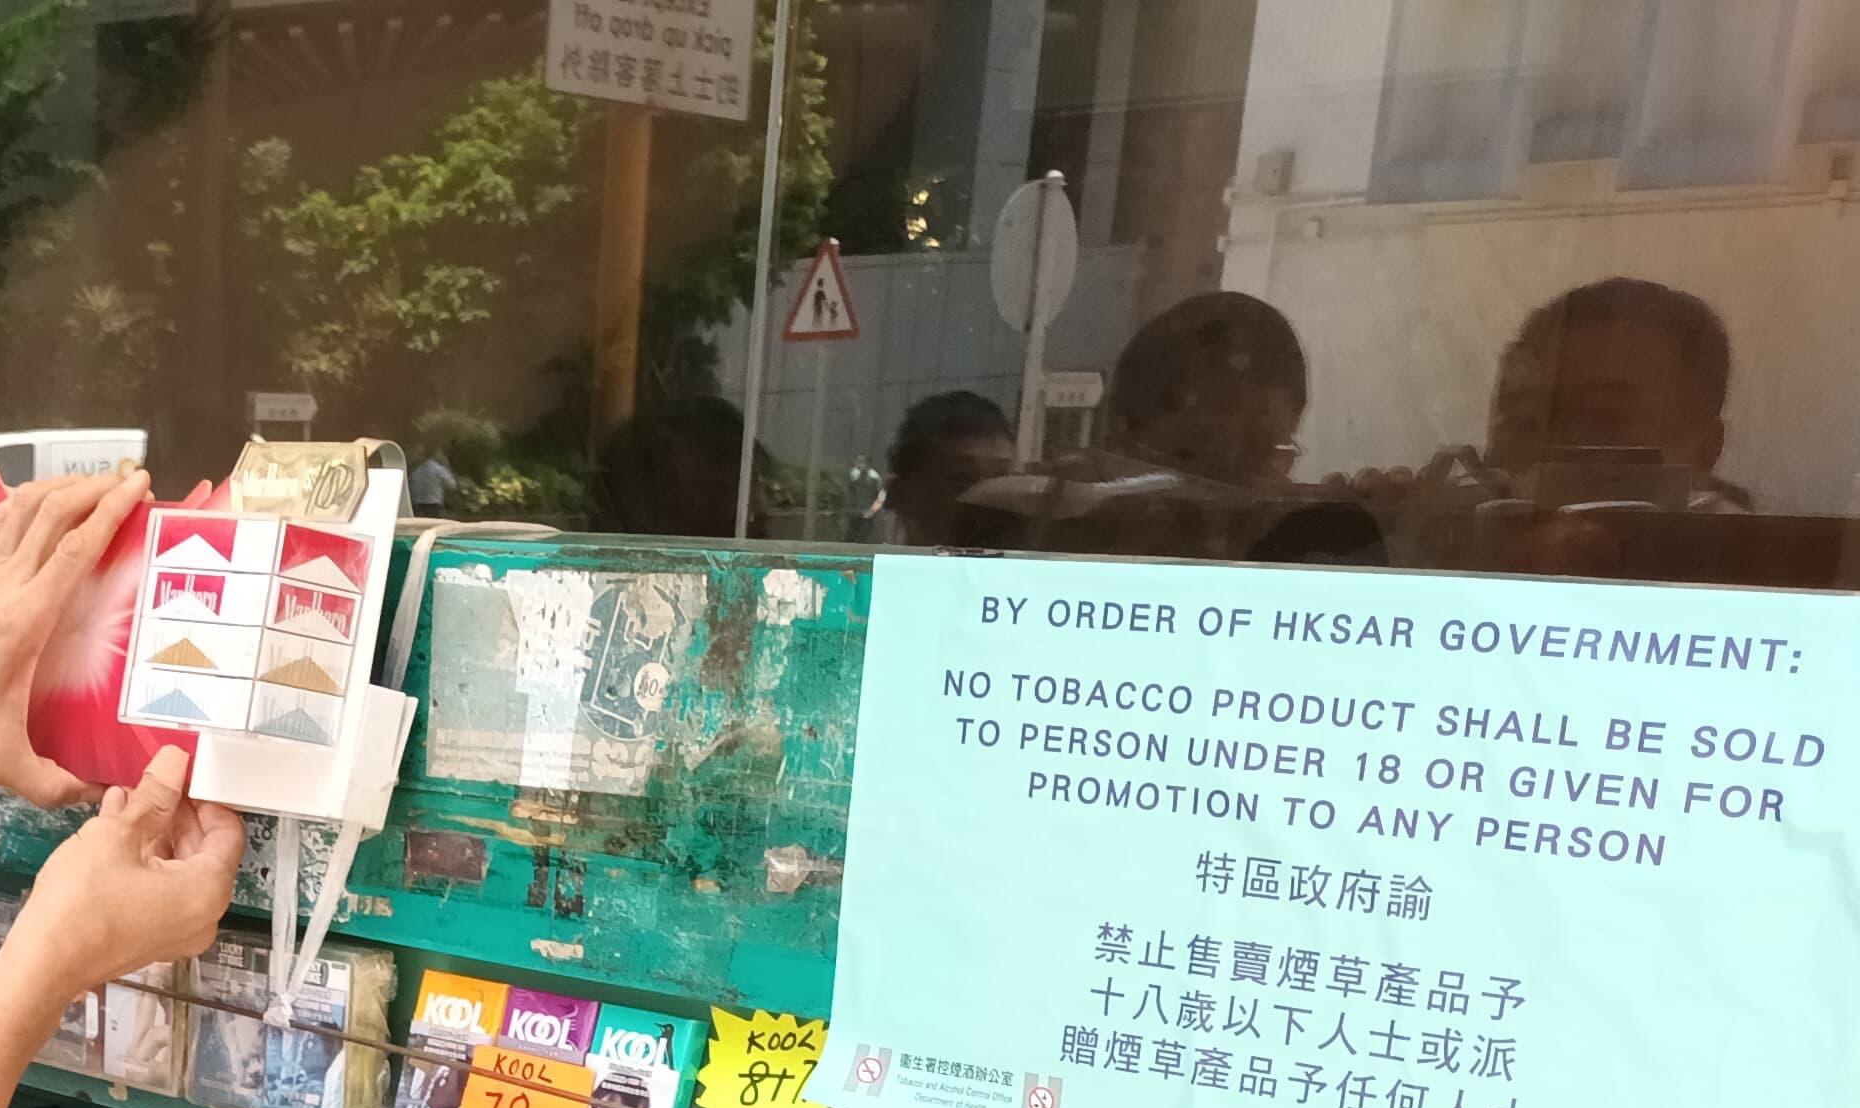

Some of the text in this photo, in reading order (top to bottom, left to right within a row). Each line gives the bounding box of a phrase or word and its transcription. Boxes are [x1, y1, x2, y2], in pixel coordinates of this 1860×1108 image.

[981, 595, 1803, 675] BY ORDER OF HKSAR GOVERNMENT:
[943, 668, 1826, 769] NO TOBACCO PRODUCT SHALL BE SOLD
[955, 717, 1785, 823] TO PERSON UNDER 18 OR GIVEN FOR
[1027, 771, 1667, 867] PROMOTION TO ANY PERSON
[1194, 849, 1434, 922] 特區政府諭
[1093, 920, 1527, 1022] 禁止售賣煙草產品予
[423, 991, 486, 1034] KOOL
[507, 1008, 574, 1051] KOOL
[1089, 975, 1517, 1083] 十八歲以下人士或派
[493, 1053, 554, 1085] KOOL
[599, 1026, 668, 1067] KOOL
[746, 1030, 817, 1054] KOOL
[896, 1073, 1013, 1104] Tobacco and Alcohol Control Office
[914, 1092, 954, 1107] Department
